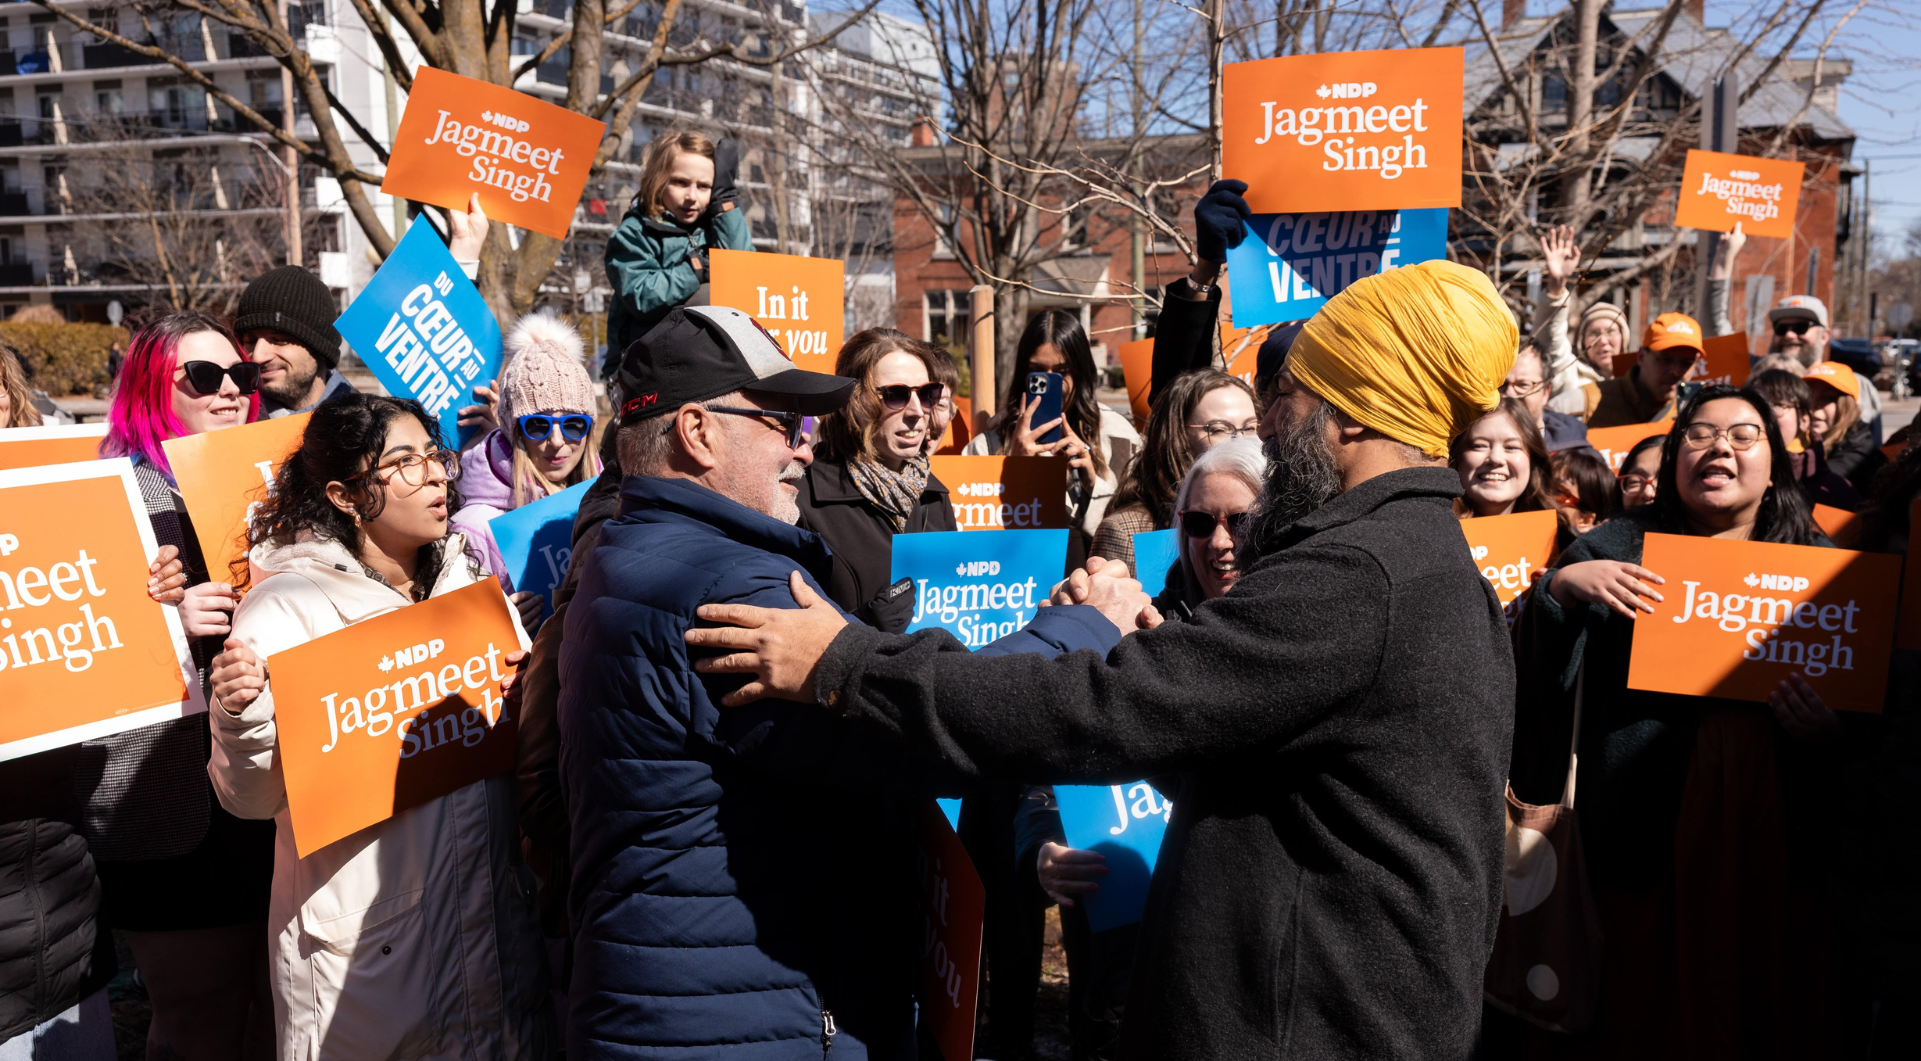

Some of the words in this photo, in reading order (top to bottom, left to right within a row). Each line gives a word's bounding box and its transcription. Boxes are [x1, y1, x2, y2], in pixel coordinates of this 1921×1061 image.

[1332, 82, 1377, 99] NDP
[492, 112, 530, 133] NDP
[1255, 98, 1428, 145] Jagmeet
[424, 109, 565, 175] Jagmeet
[1323, 134, 1427, 179] Singh
[468, 155, 552, 202] Singh
[1697, 172, 1783, 201] Jagmeet
[1378, 213, 1401, 234] AU
[1726, 197, 1778, 222] Singh
[434, 270, 454, 297] DU
[756, 286, 786, 319] In
[791, 285, 809, 321] it
[785, 329, 828, 360] you
[374, 312, 460, 421] VENTRE
[460, 358, 481, 381] AU
[970, 483, 1005, 497] NDP
[967, 560, 1000, 577] NPD
[1761, 574, 1809, 592] NDP
[911, 576, 1037, 623] Jagmeet
[1672, 580, 1860, 633] Jagmeet
[395, 638, 445, 669] NDP
[1743, 624, 1854, 677] Singh
[320, 642, 506, 753] Jagmeet
[397, 687, 511, 759] Singh
[931, 857, 950, 927] it
